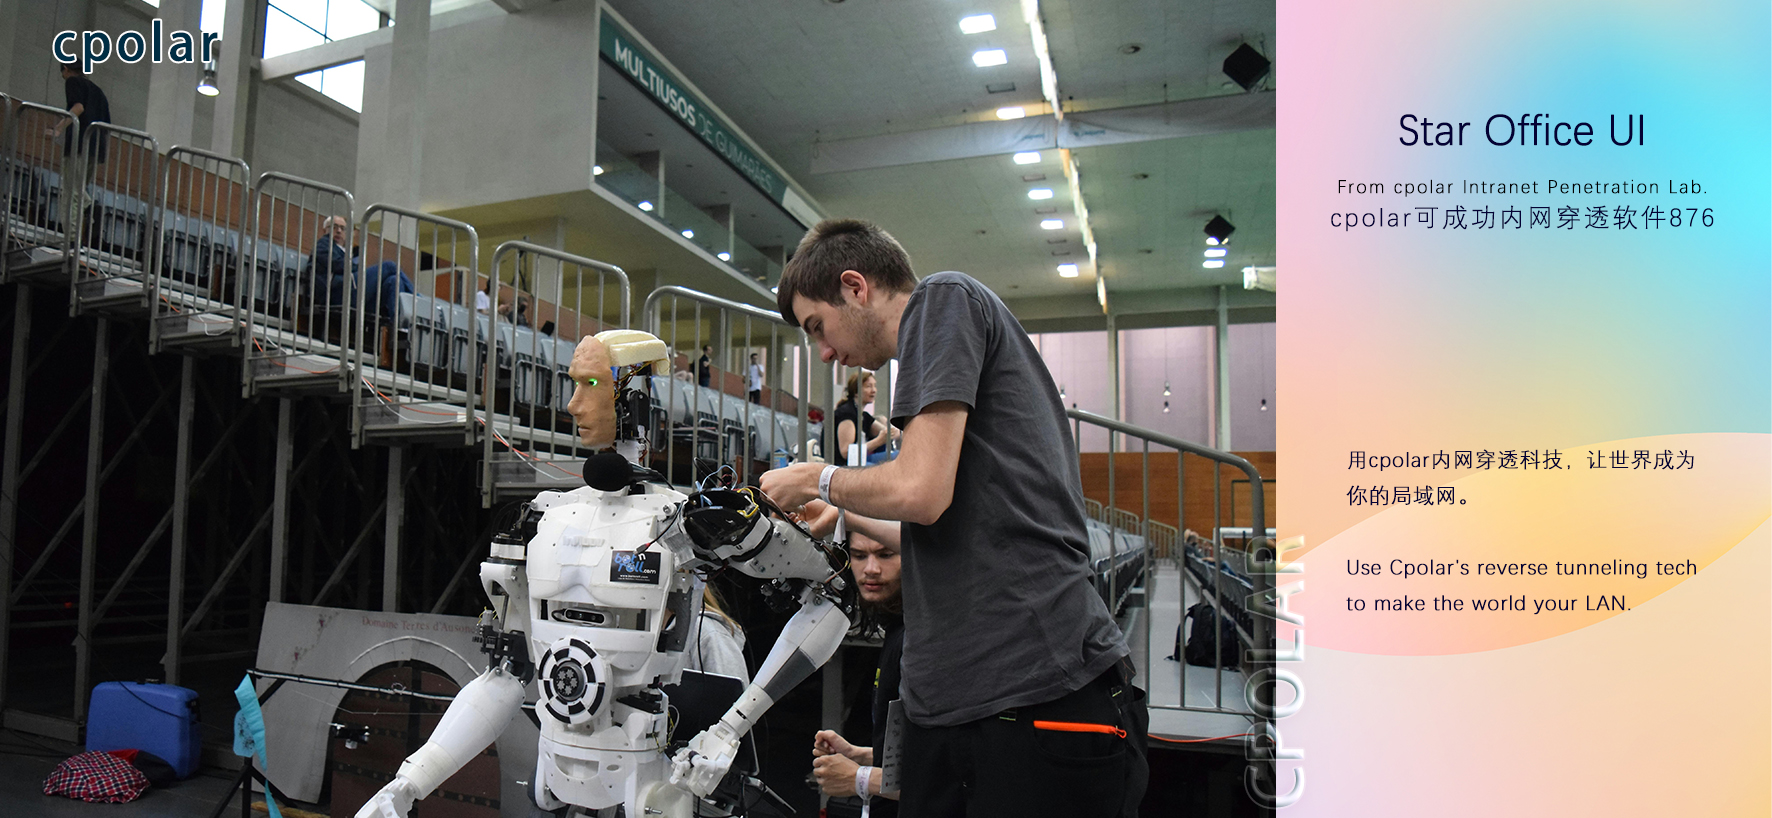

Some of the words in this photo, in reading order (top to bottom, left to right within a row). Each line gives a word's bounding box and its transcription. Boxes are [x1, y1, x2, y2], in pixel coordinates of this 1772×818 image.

[614, 38, 696, 127] MULTIUSOS
[698, 112, 713, 145] DE
[614, 553, 637, 564] bot
[638, 553, 647, 561] n
[363, 616, 398, 629] Domaine
